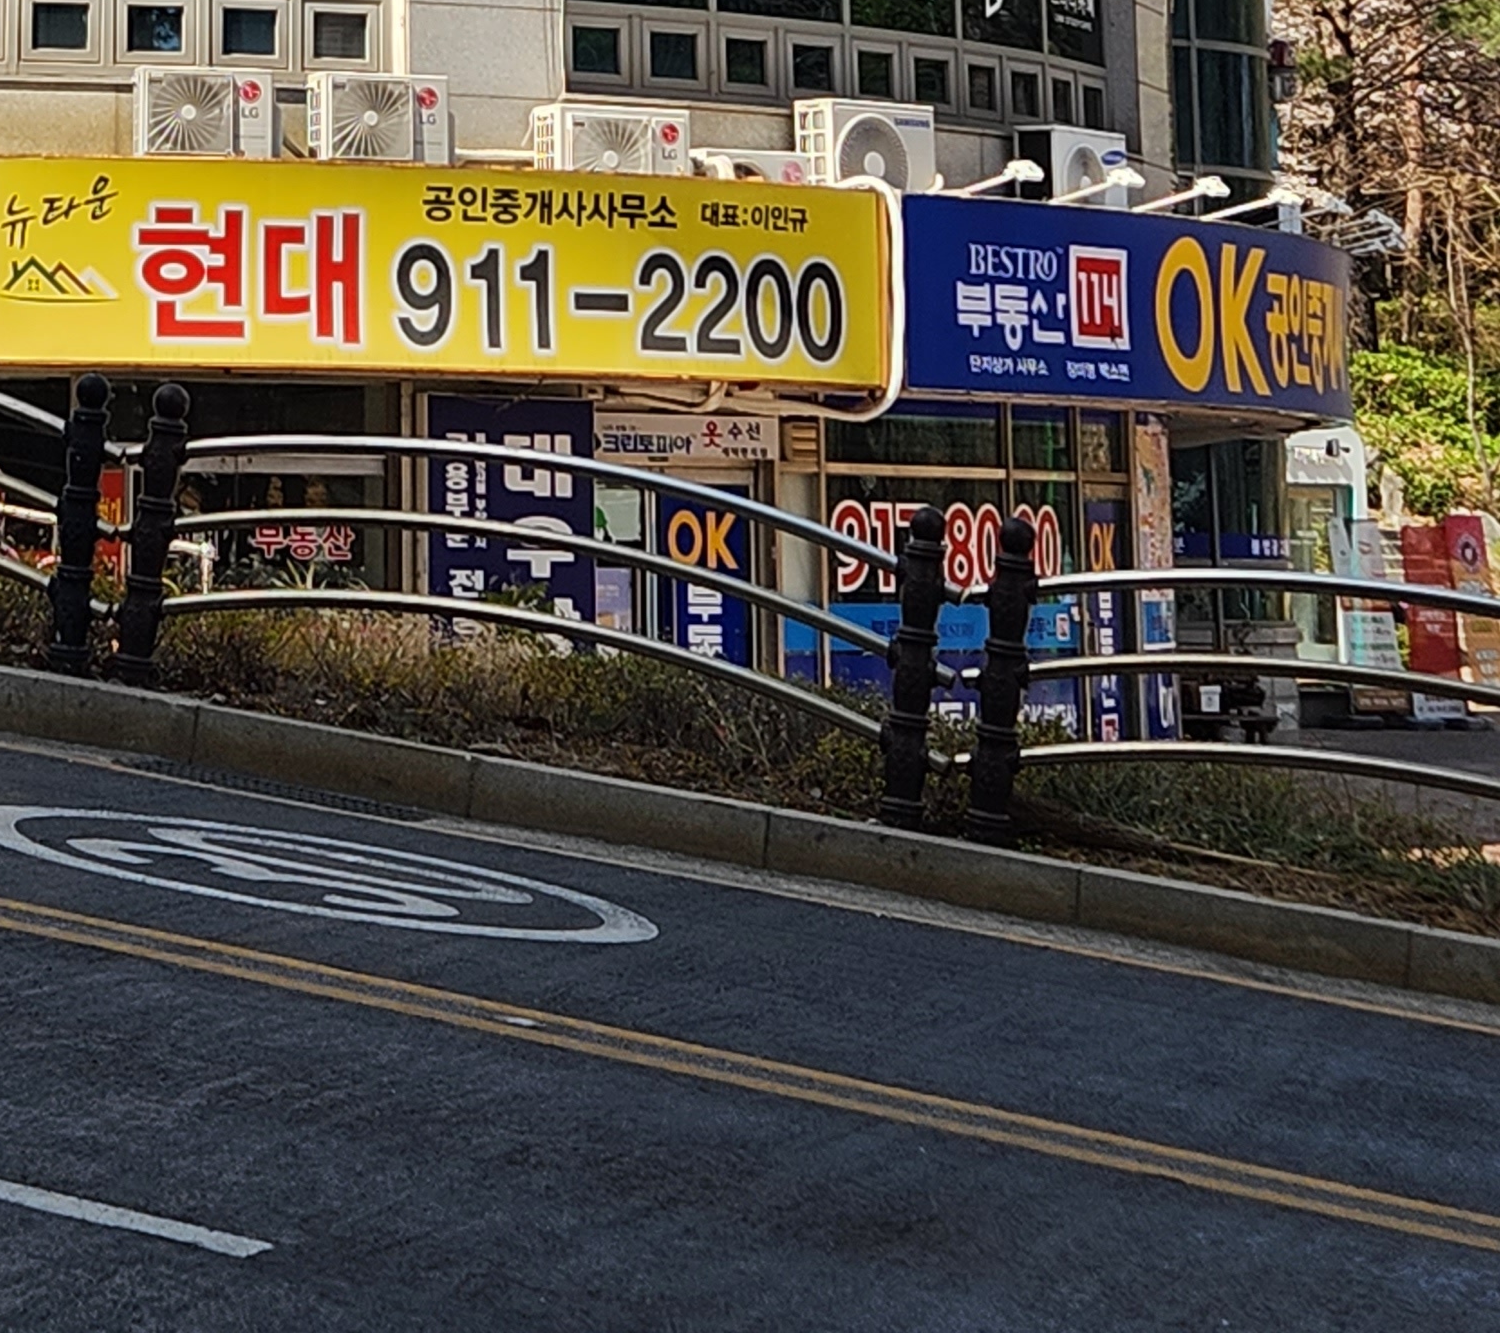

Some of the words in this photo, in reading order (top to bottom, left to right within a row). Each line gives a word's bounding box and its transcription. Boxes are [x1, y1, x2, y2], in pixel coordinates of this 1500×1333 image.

[240, 106, 261, 120] LG
[418, 113, 438, 127] LG
[660, 147, 679, 161] LG
[0, 174, 120, 249] 뉴타운
[421, 184, 680, 231] 공인중개사사무소
[137, 203, 366, 346] 현대
[395, 241, 845, 365] 911-2200
[968, 242, 1058, 282] BESTRO
[955, 280, 1067, 352] 부동산
[1077, 271, 1120, 328] 114
[1155, 235, 1271, 397] OK
[701, 419, 724, 449] 옷
[727, 421, 762, 442] 수선
[667, 508, 740, 571] OK
[1089, 521, 1116, 572] OK
